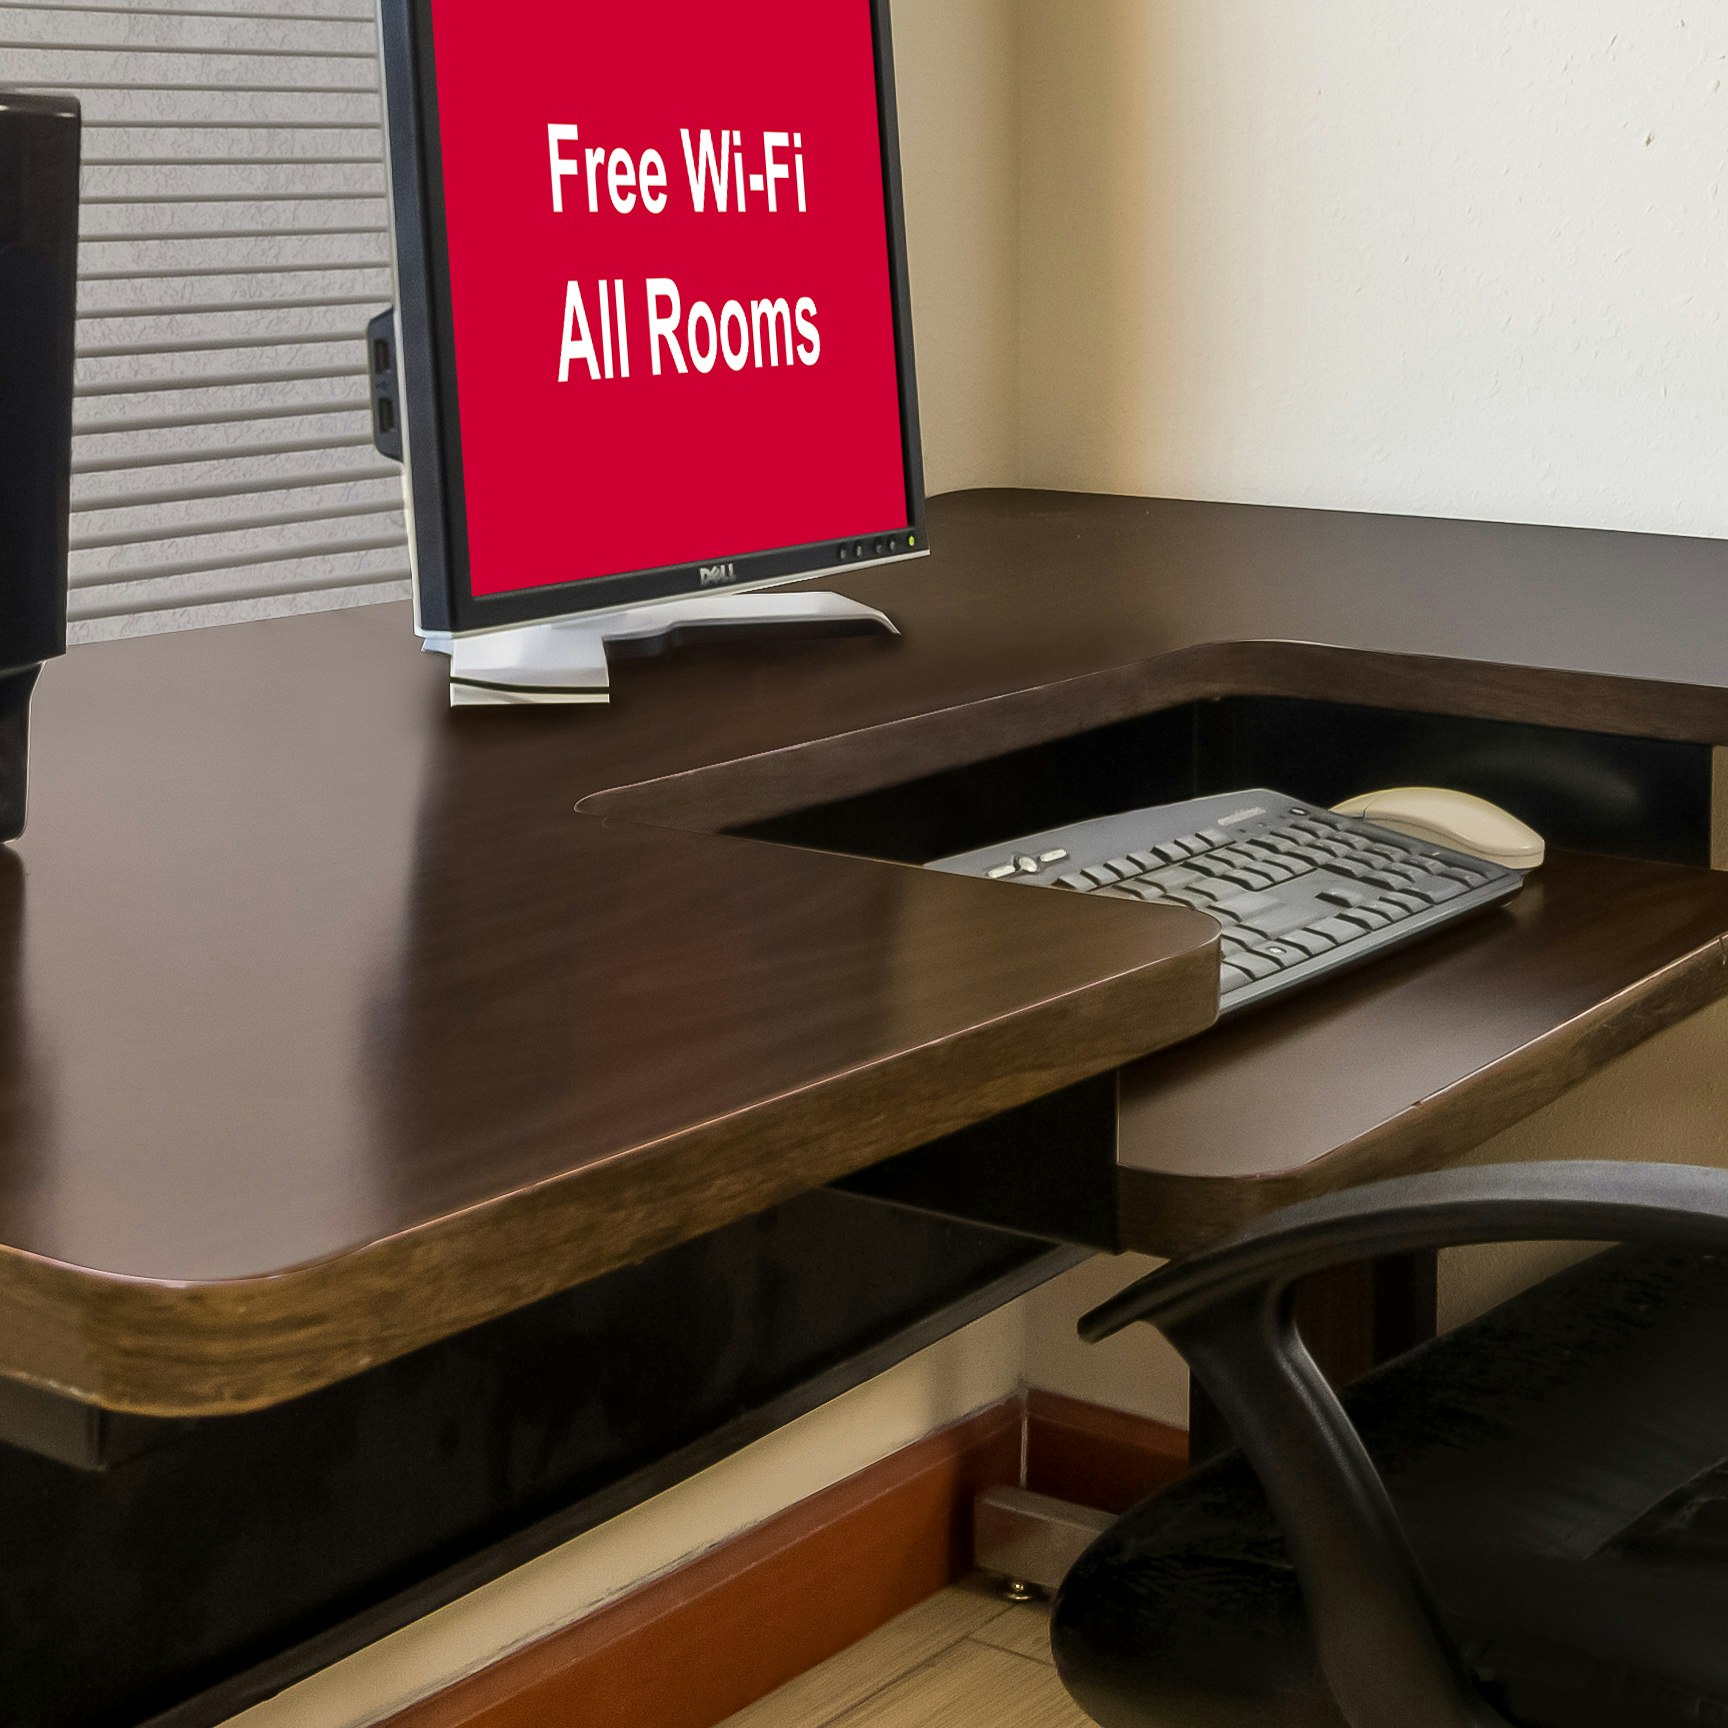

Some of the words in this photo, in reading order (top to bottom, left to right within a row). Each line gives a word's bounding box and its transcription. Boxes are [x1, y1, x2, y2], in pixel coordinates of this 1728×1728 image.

[547, 123, 668, 214] Free
[679, 128, 807, 213] Wi-Fi
[558, 278, 631, 383] All
[645, 277, 821, 376] Rooms
[699, 563, 737, 586] DELL
